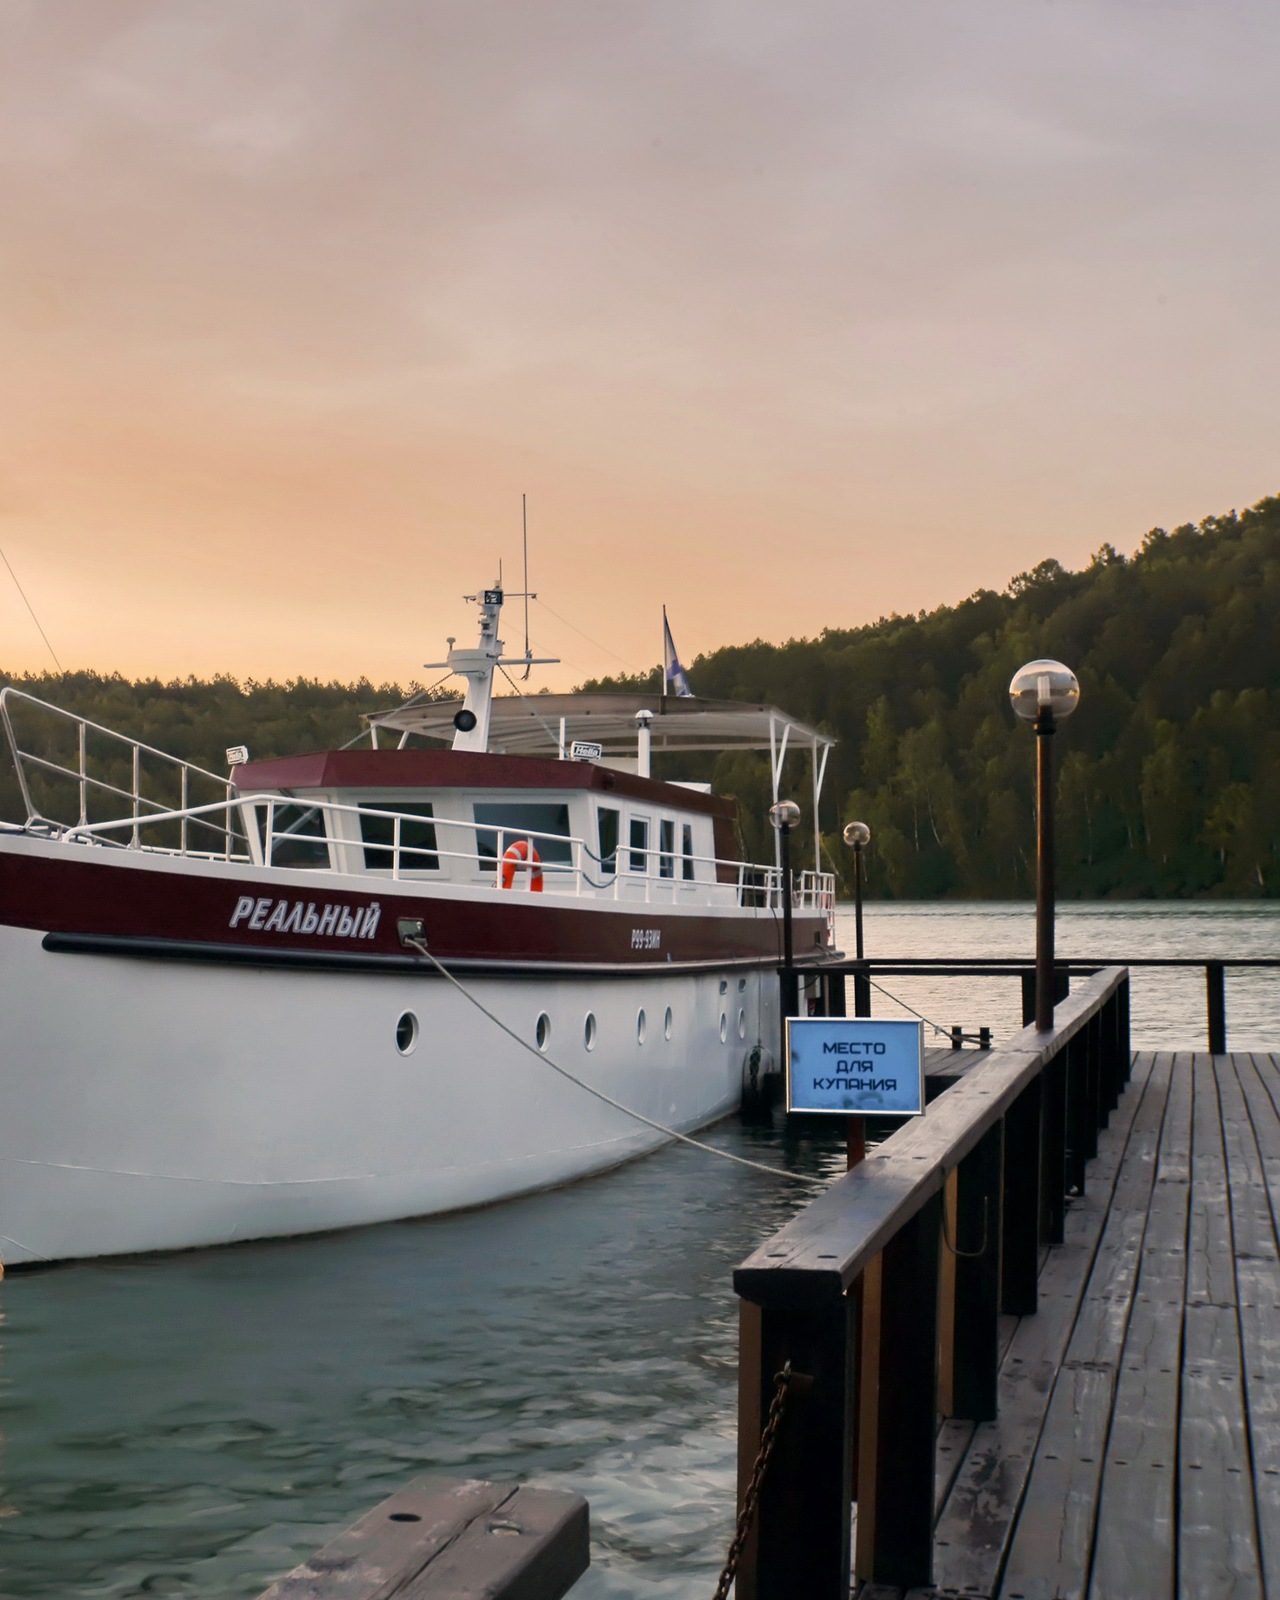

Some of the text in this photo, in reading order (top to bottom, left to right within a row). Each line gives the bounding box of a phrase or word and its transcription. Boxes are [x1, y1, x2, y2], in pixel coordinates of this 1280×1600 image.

[229, 896, 381, 939] РЕАЛЬНЫЙ
[823, 1042, 886, 1055] МЕСТО
[836, 1060, 874, 1074] ДЛЯ
[813, 1078, 897, 1091] КУПАНИЯ
